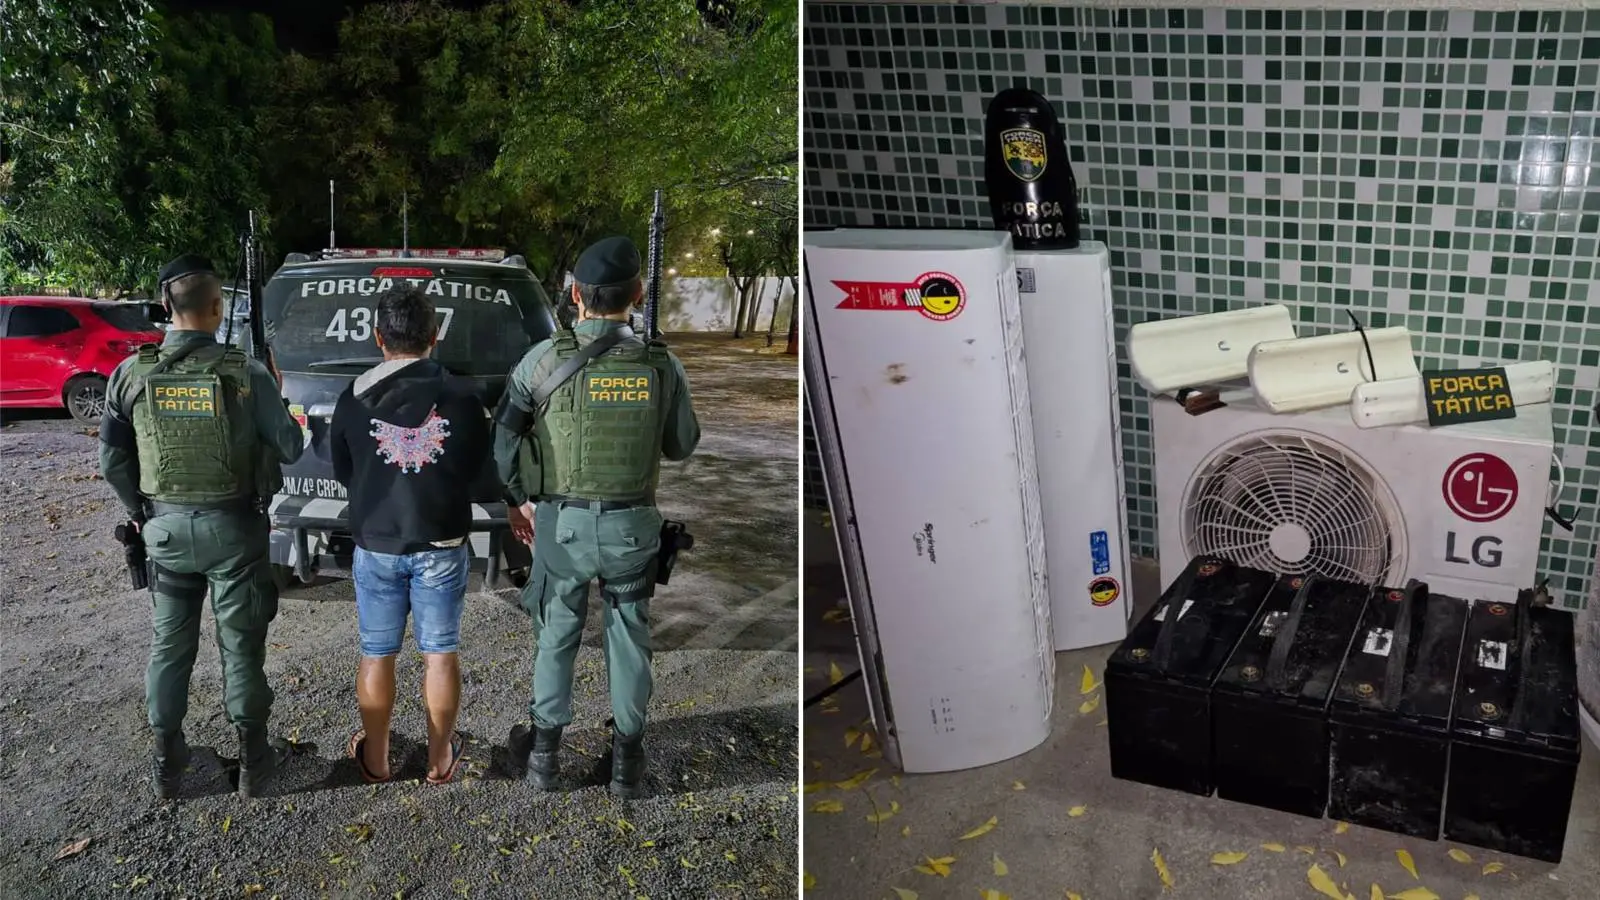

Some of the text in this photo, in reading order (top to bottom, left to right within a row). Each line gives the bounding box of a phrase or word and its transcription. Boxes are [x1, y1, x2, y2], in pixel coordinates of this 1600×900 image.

[301, 276, 512, 306] FORÇA TÁTICA
[1429, 374, 1504, 395] FORÇA
[589, 389, 649, 402] TÁTICA
[1431, 394, 1512, 416] TÁTICA
[316, 478, 348, 498] CRPM
[1445, 531, 1503, 568] LG
